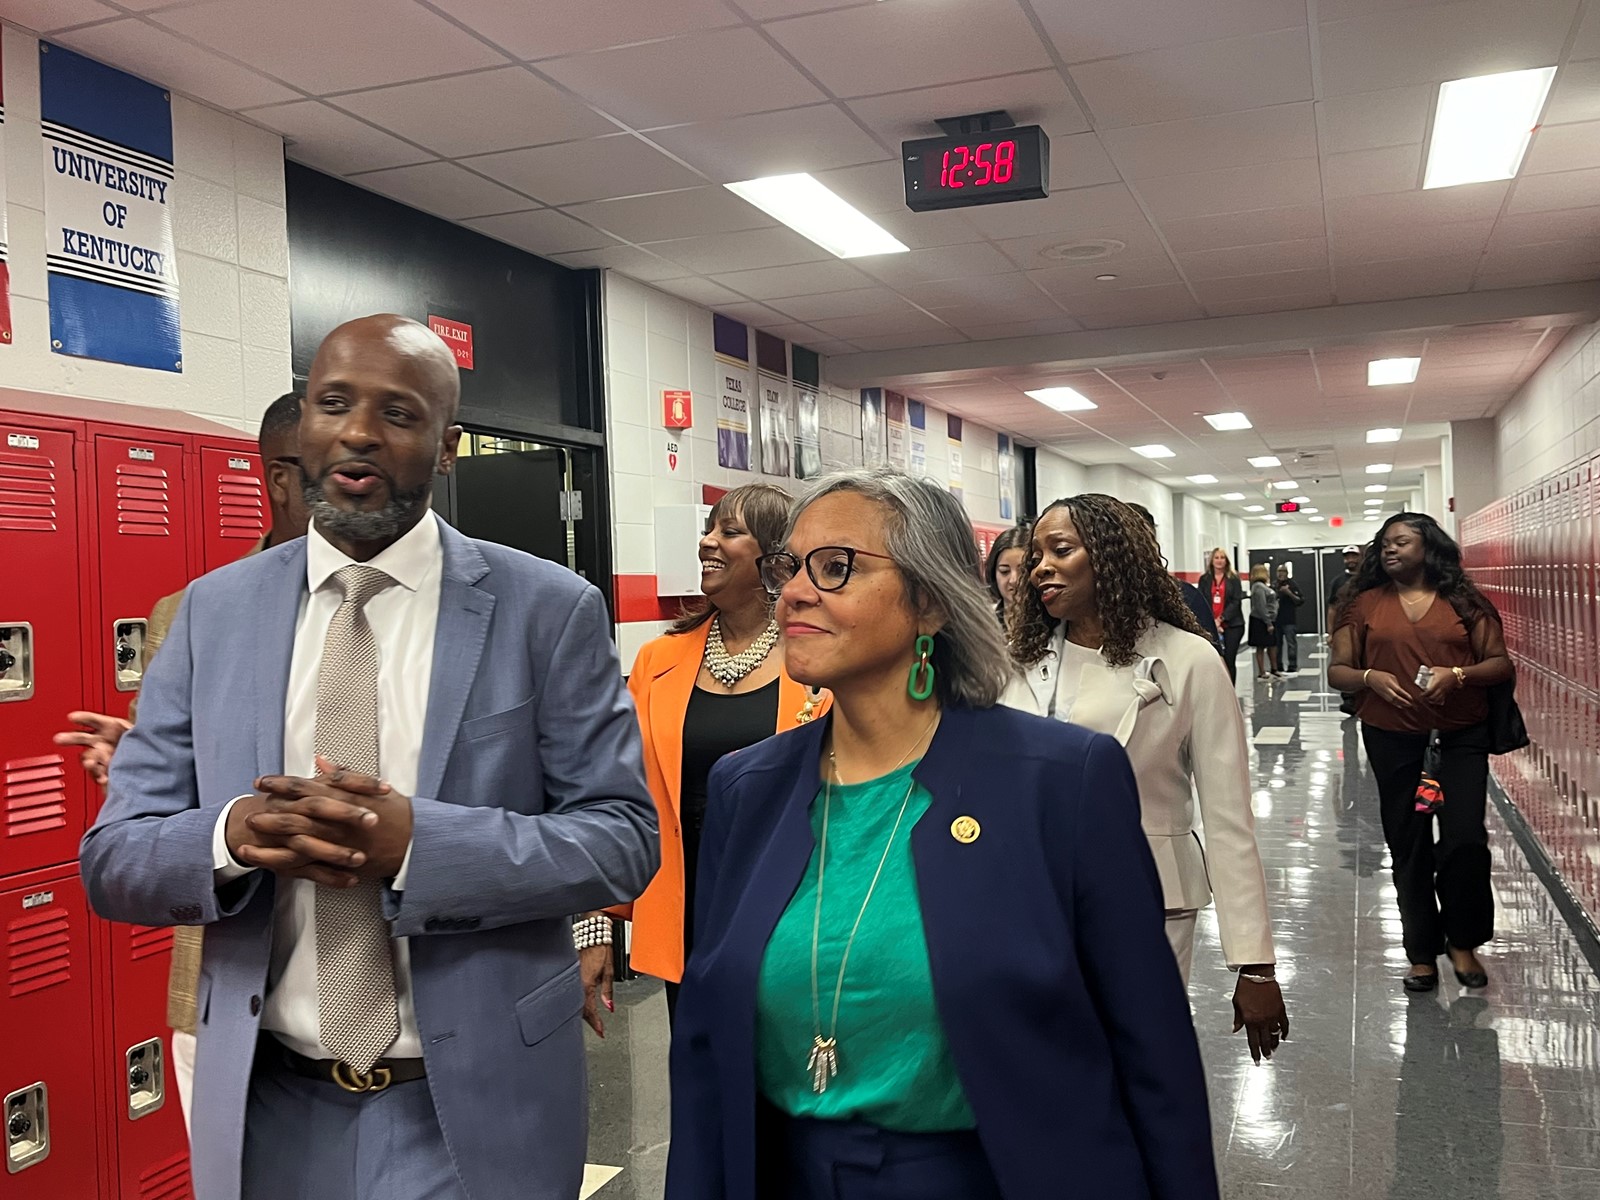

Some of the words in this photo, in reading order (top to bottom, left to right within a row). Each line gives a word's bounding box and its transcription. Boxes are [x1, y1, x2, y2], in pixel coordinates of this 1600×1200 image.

[941, 139, 1015, 188] 12:58
[52, 146, 168, 205] UNIVERSITY
[103, 201, 127, 230] OF
[62, 228, 165, 276] KENTUCKY
[434, 324, 450, 336] FIRE
[452, 329, 468, 342] EXIT
[725, 377, 742, 392] TEXAS
[722, 395, 746, 412] COLLEGE
[667, 442, 678, 453] AED
